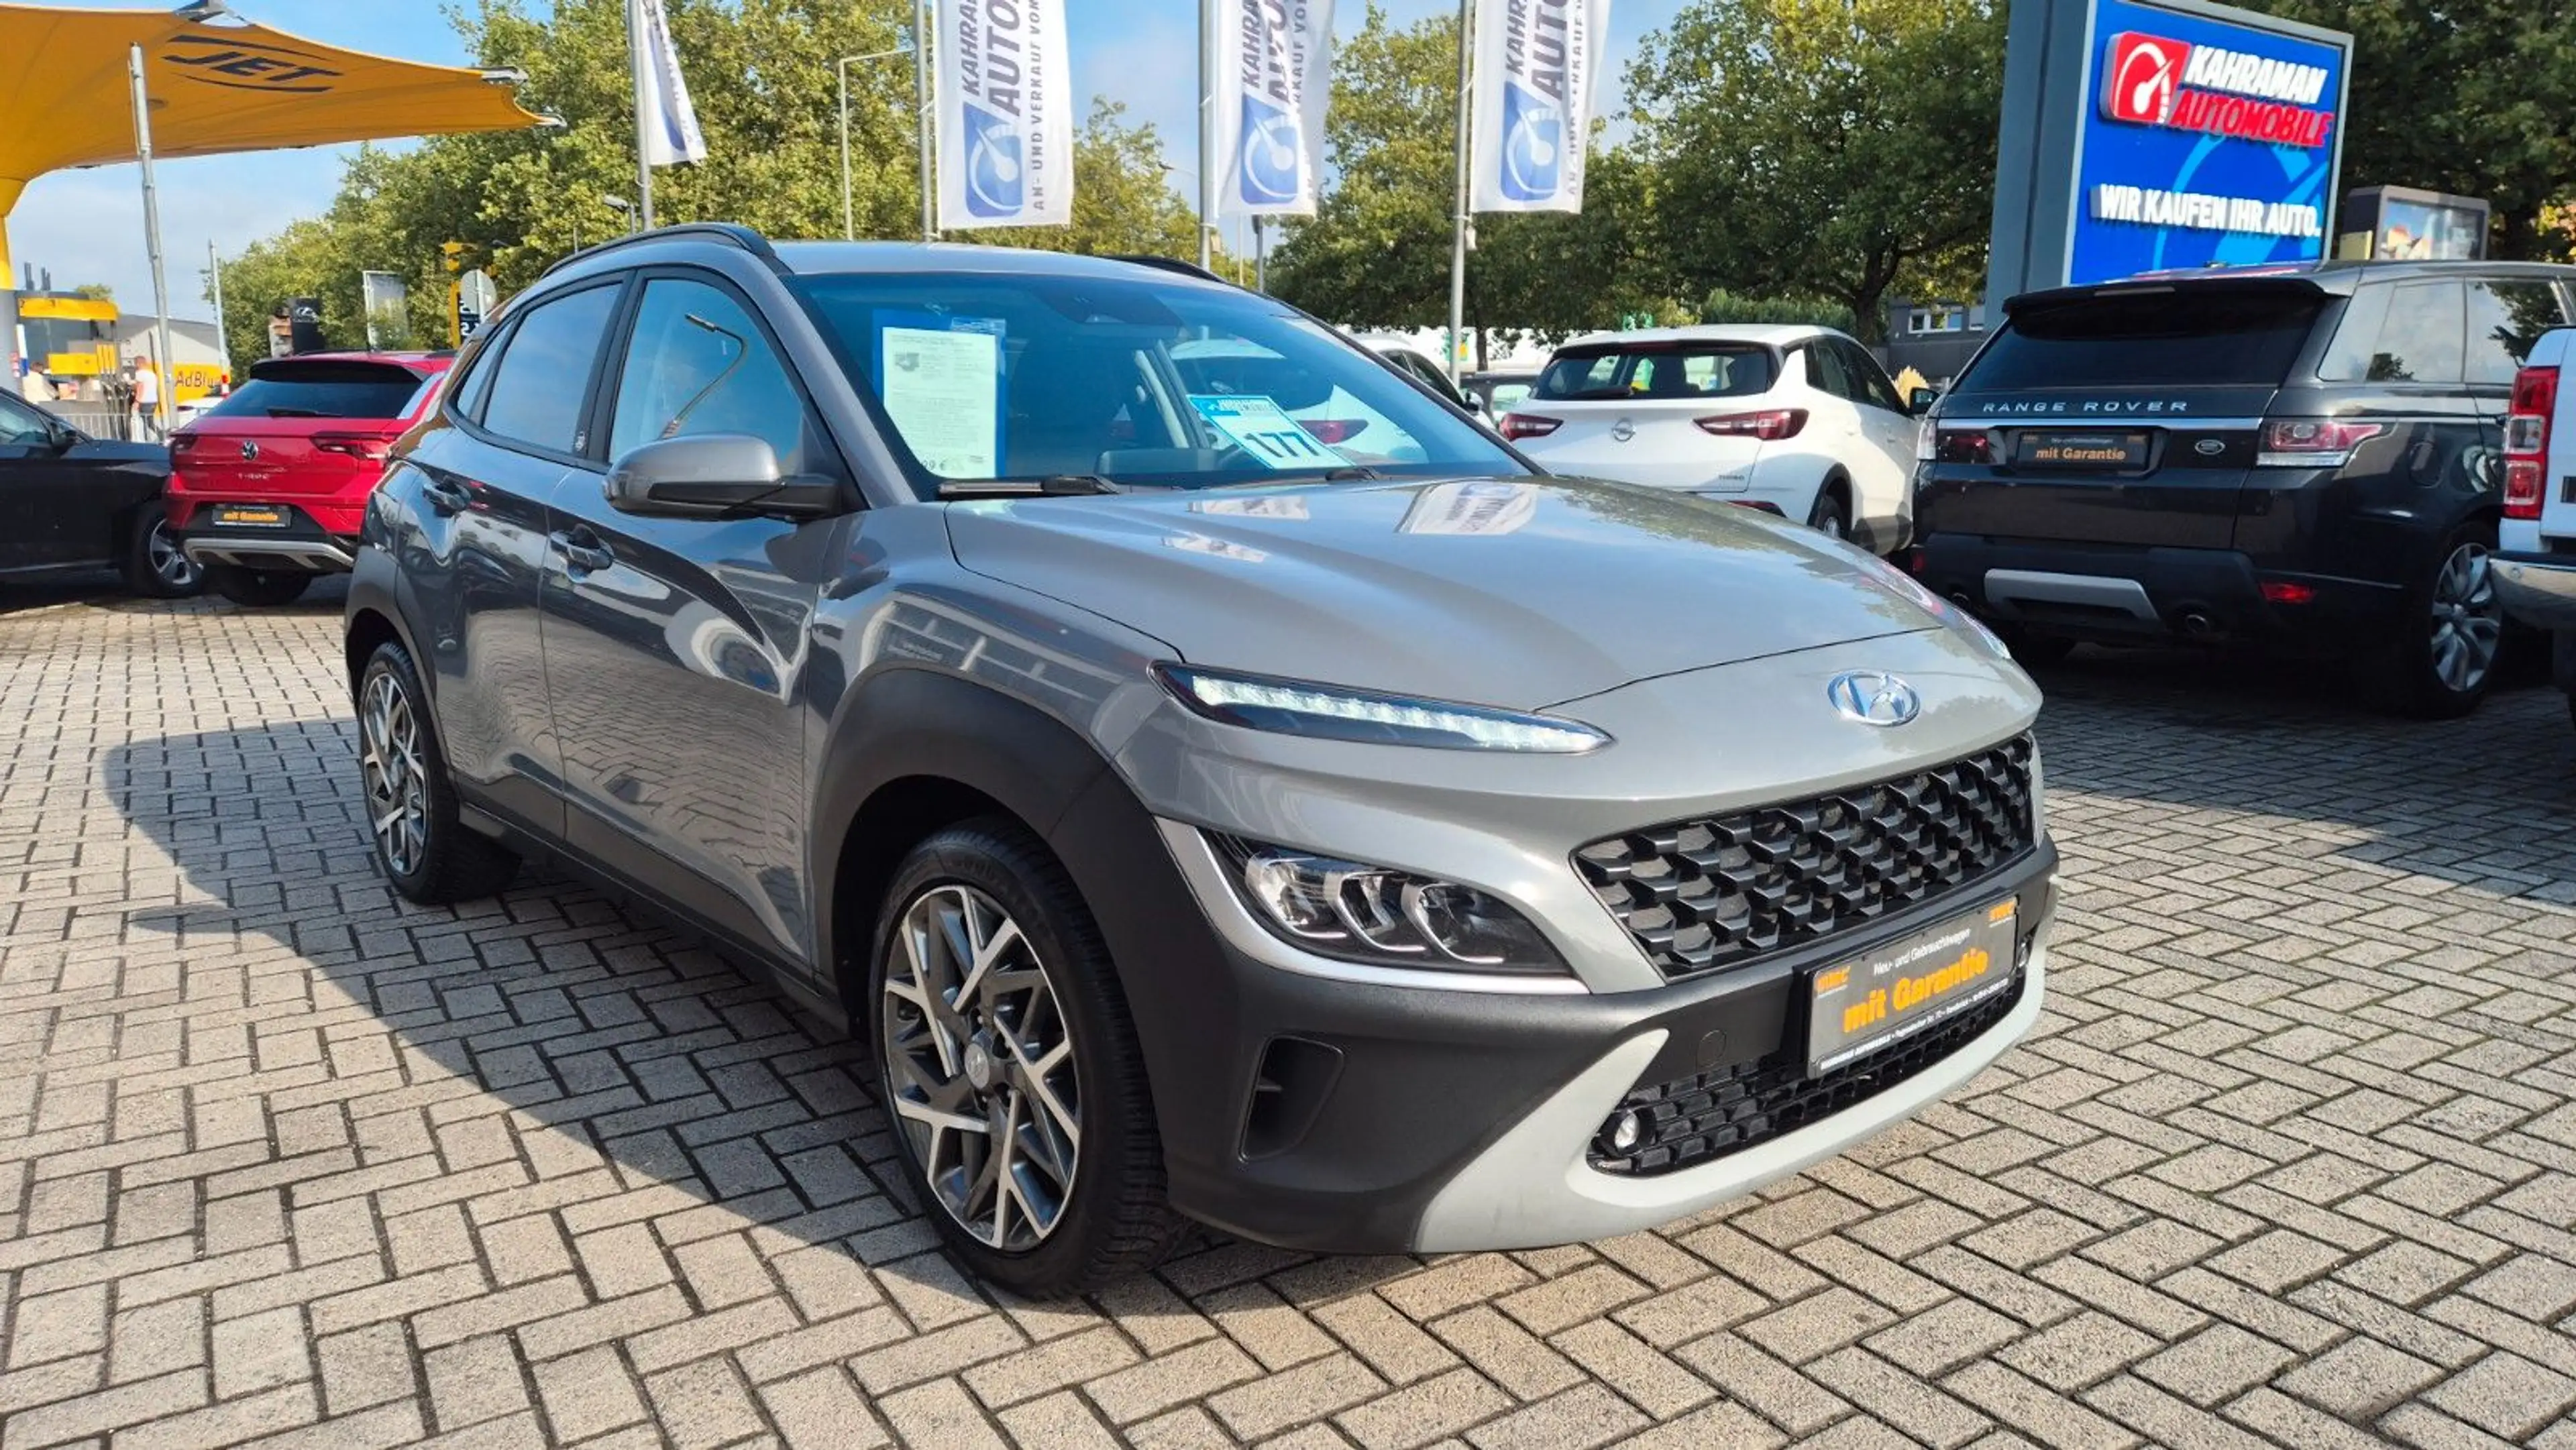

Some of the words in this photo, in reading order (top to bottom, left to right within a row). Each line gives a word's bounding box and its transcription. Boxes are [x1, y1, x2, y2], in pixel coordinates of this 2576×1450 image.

[161, 51, 343, 82] JET
[985, 0, 1020, 117] AUTO
[2185, 45, 2328, 104] KAHRAMAN
[1030, 43, 1044, 125] VERKAUF
[2168, 90, 2335, 148] AUTOMOBILE
[1032, 133, 1044, 170] UND
[1034, 178, 1044, 211] AN-
[2100, 183, 2141, 221] WIR
[2143, 188, 2227, 231] KAUFEN
[2229, 198, 2265, 233] IHR
[2265, 203, 2322, 237] AUTO.
[1983, 402, 2067, 412] RANGE
[2083, 402, 2188, 412] ROVER
[1244, 432, 1320, 457] 177
[2036, 447, 2059, 459] mit
[2061, 446, 2127, 461] Garantie
[1894, 951, 1911, 968] und
[1843, 989, 1886, 1033] mit
[1892, 948, 1989, 1011] Garantie
